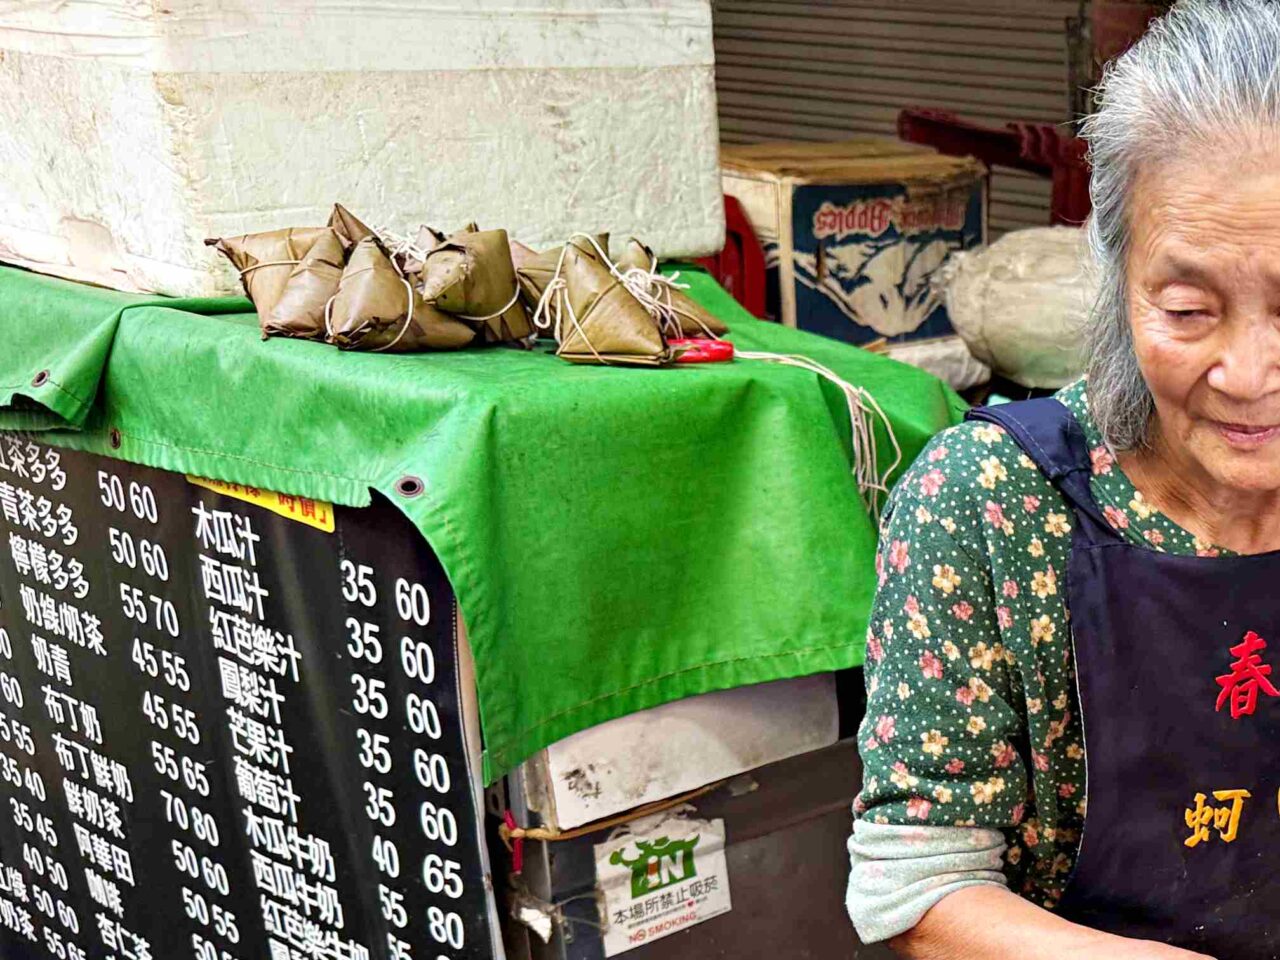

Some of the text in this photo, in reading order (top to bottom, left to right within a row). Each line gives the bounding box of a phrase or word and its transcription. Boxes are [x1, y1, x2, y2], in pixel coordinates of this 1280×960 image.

[816, 200, 891, 236] Apples
[98, 470, 125, 512] 50
[129, 481, 158, 524] 60
[9, 531, 179, 637] 檸檬多多 55 70
[109, 527, 136, 569] 50
[140, 539, 169, 582] 60
[192, 500, 430, 627] 木瓜汁 35 60
[199, 553, 435, 684] 西瓜汁 35 60
[0, 672, 23, 708] 60
[31, 633, 200, 745] 奶青 45 55
[132, 637, 158, 677] 45
[162, 650, 190, 692] 55
[209, 605, 441, 740] 紅芭樂汁 35 60
[1215, 630, 1280, 720] 春
[12, 719, 35, 756] 55
[41, 684, 210, 796] 布丁奶 55 65
[218, 656, 450, 794] 鳳梨汁 35 60
[0, 753, 46, 802] 35 40
[52, 732, 219, 847] 布丁鮮奶 70 80
[226, 705, 457, 846] 芒果汁 35 60
[10, 797, 58, 847] 35 45
[63, 777, 230, 896] 鮮奶茶 50 60
[233, 755, 463, 899] 葡萄汁 40 65
[23, 843, 69, 892] 40 50
[32, 884, 55, 919] 50
[57, 900, 80, 934] 60
[73, 822, 240, 944] 阿華田 50 55
[242, 805, 465, 950] 木瓜牛奶 55 80
[250, 849, 344, 929] 西瓜牛奶
[613, 875, 720, 926] 本場所禁止吸菸
[43, 927, 67, 960] 55
[648, 911, 698, 938] SMOKING
